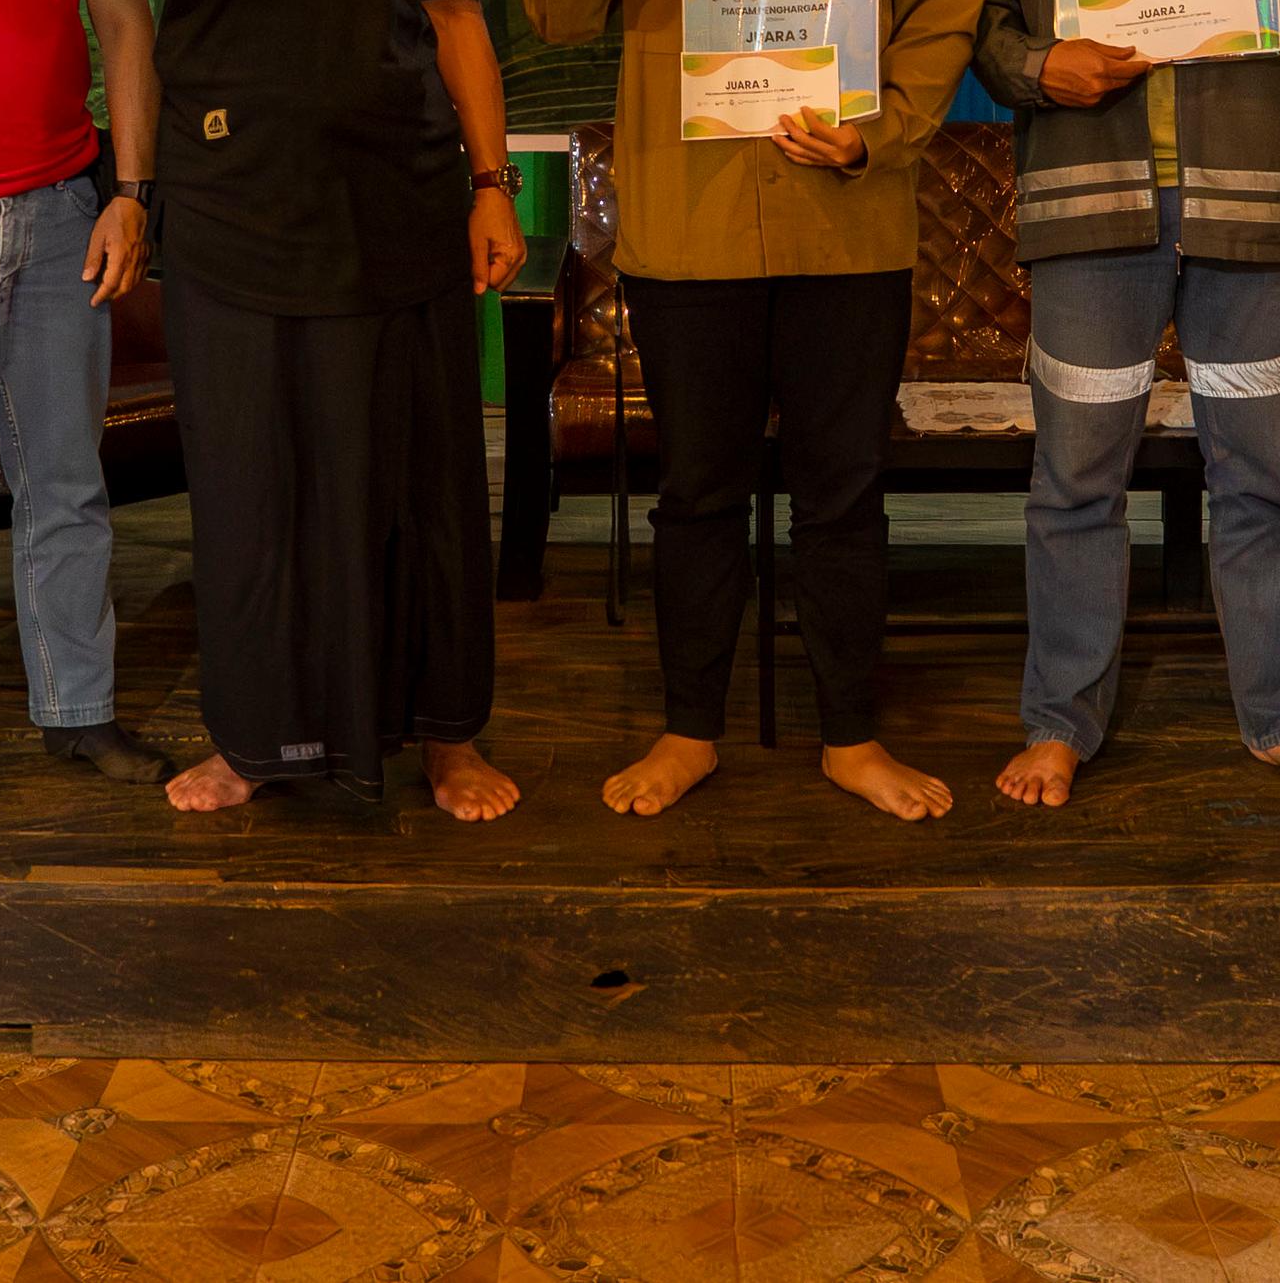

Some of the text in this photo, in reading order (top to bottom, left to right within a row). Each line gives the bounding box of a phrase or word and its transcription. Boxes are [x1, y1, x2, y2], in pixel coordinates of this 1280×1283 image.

[1138, 4, 1186, 19] JUARA 2
[799, 29, 808, 40] 3
[725, 79, 769, 90] JUARA 3
